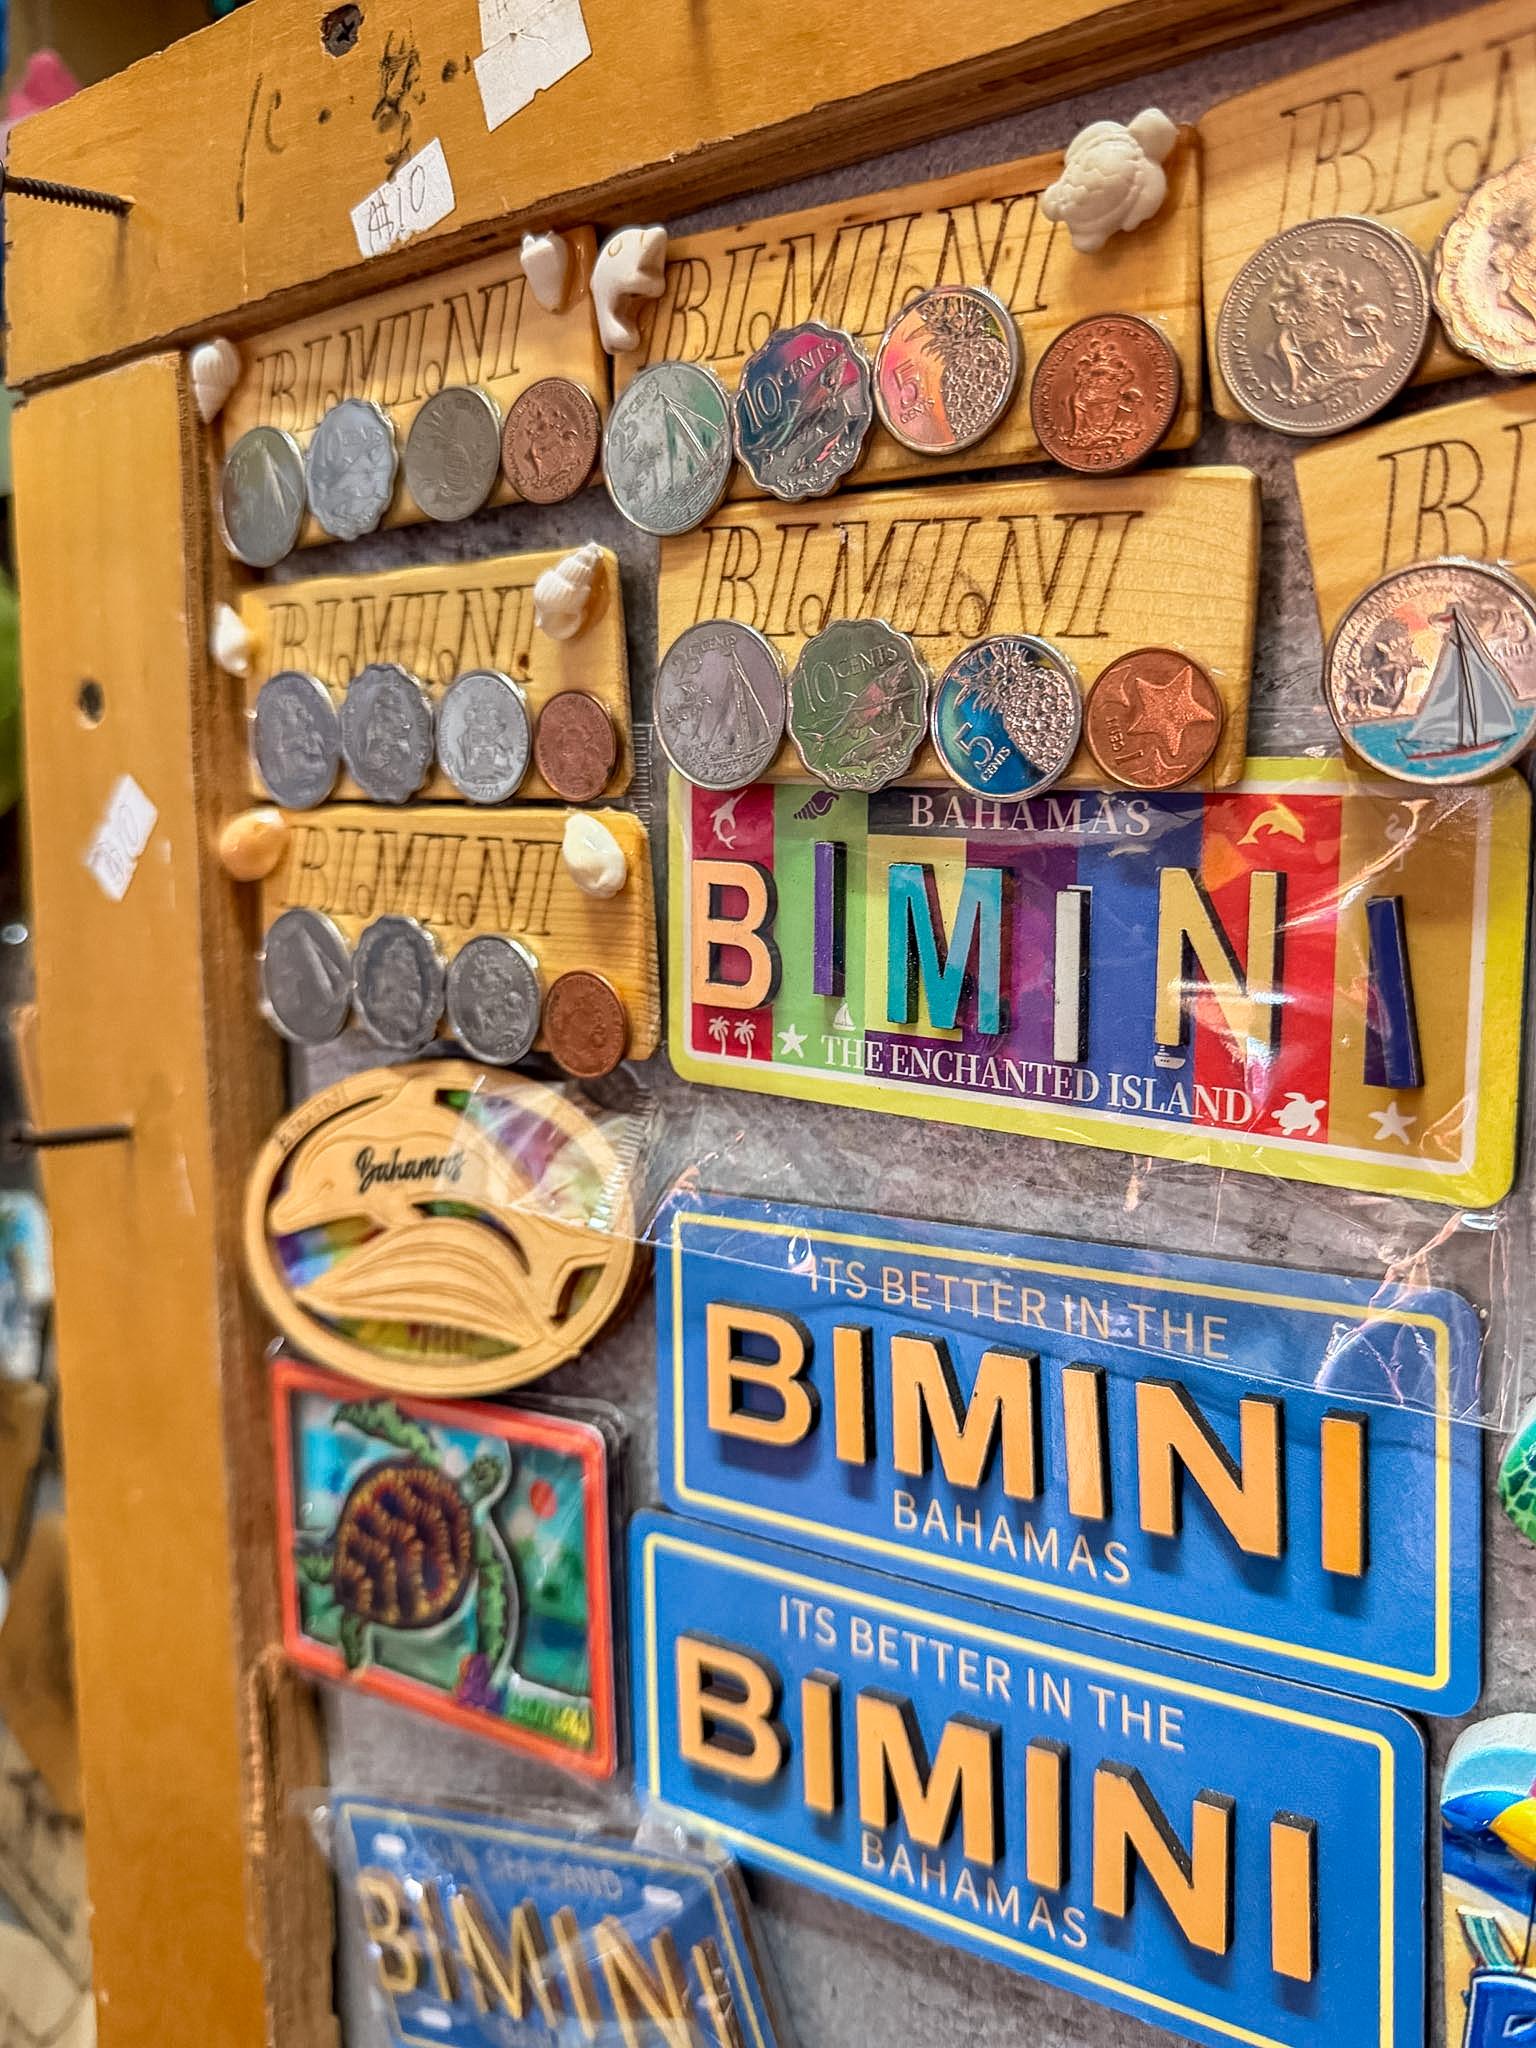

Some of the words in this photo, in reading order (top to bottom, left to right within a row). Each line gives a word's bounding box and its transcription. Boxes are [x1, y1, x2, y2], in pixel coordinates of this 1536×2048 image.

[640, 190, 1058, 370] BIMINI
[255, 275, 527, 435] BIMINI
[743, 376, 782, 432] 10
[893, 358, 920, 407] 5
[693, 510, 1142, 640] BIMINI
[800, 660, 841, 712] 10
[836, 645, 898, 678] CENTS
[953, 721, 995, 772] 5
[980, 747, 1012, 782] CENTS
[909, 795, 1151, 836] BAHAMAS
[690, 839, 1424, 1090] BIMINI
[821, 1033, 890, 1075] THE
[889, 1043, 1097, 1104] ENCHANTED
[1106, 1071, 1253, 1127] ISLAND
[355, 1146, 464, 1194] Bahamas
[807, 1254, 868, 1300] ITS
[882, 1265, 1048, 1330] BETTER
[1062, 1291, 1110, 1338] IN
[1124, 1301, 1231, 1360] THE
[705, 1300, 1370, 1578] BIMINI
[893, 1490, 1131, 1586] BAHAMAS
[778, 1594, 839, 1647] ITS
[850, 1615, 1010, 1701] BETTER
[1027, 1668, 1073, 1720] IN
[1087, 1683, 1186, 1752] THE
[675, 1630, 1318, 1984] BIMINI
[861, 1830, 1089, 1951] BAHAMAS
